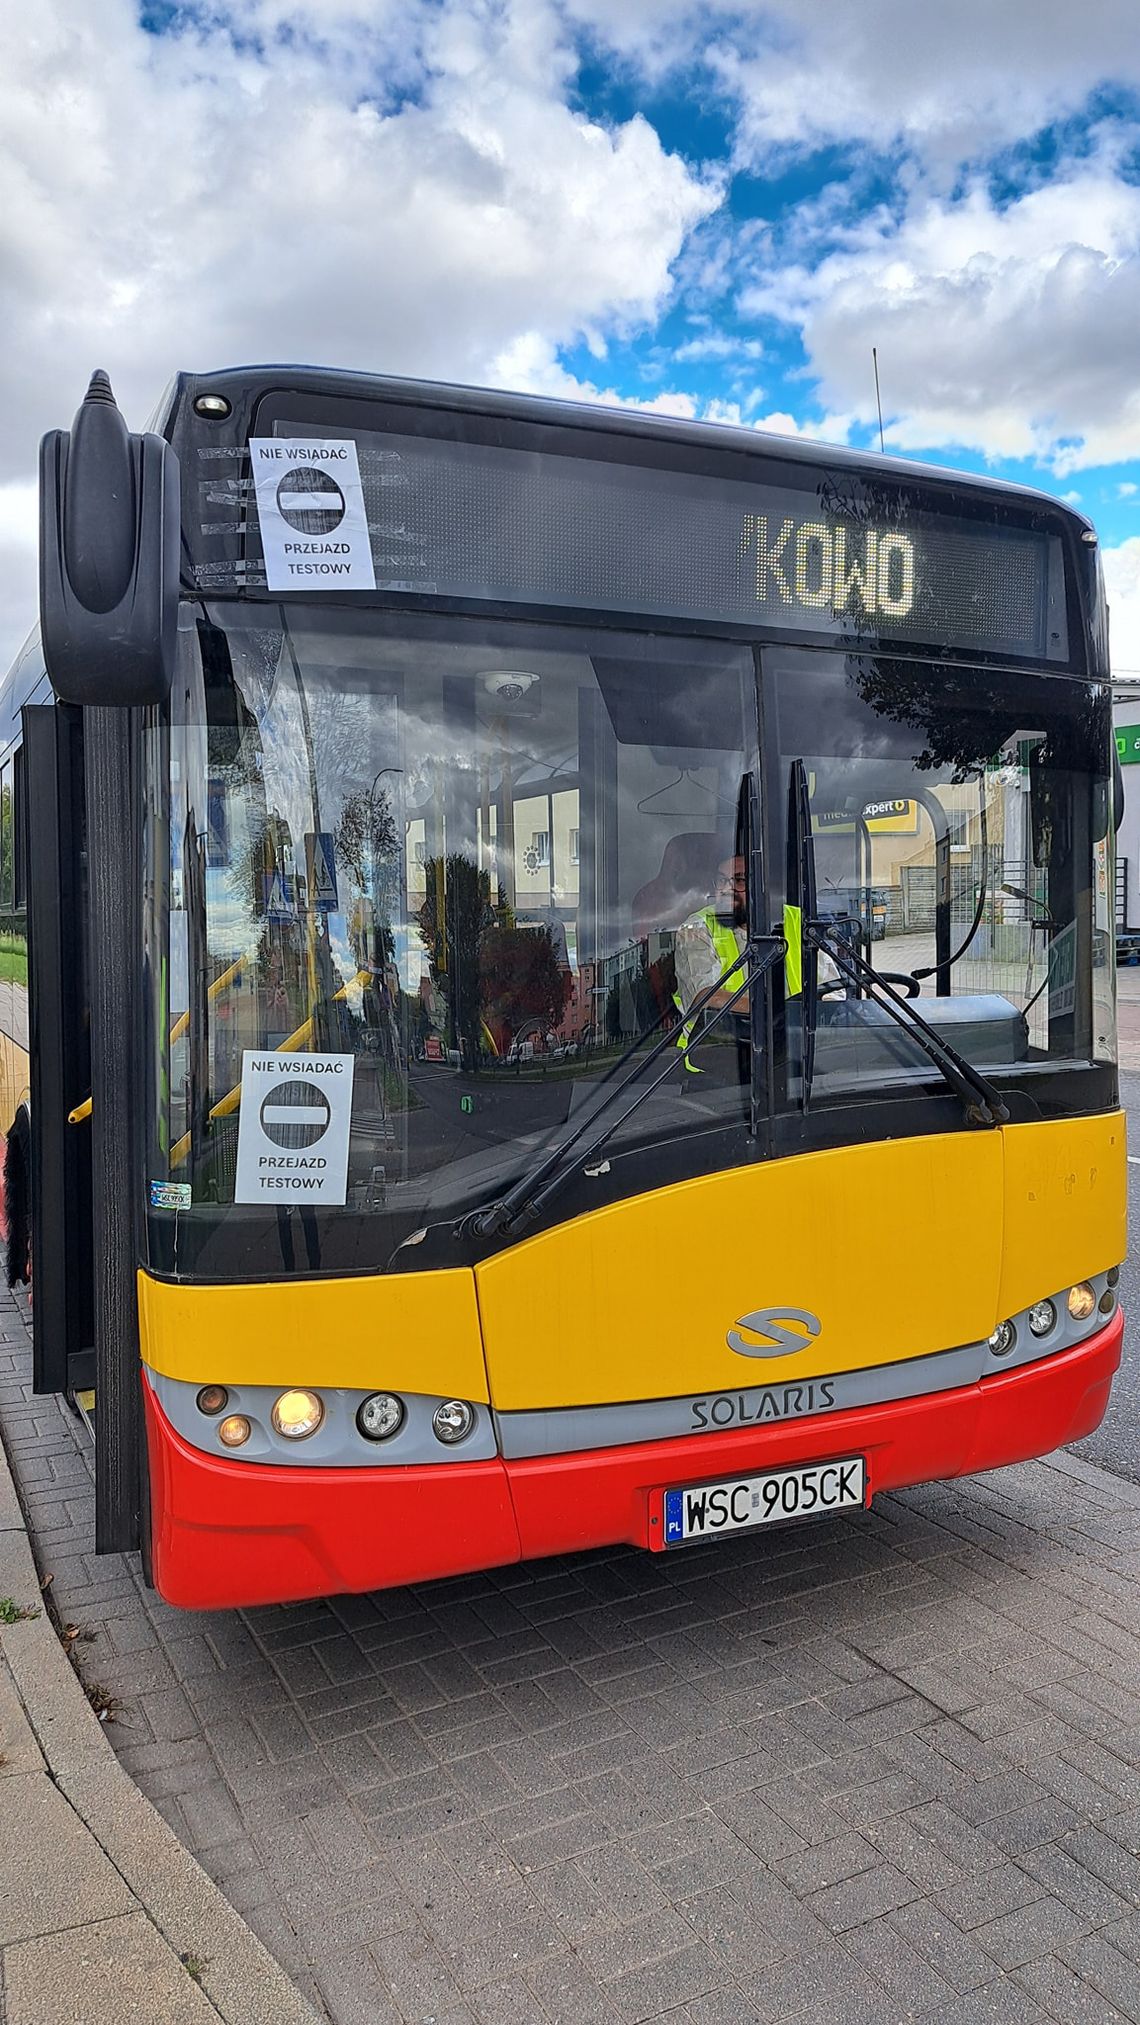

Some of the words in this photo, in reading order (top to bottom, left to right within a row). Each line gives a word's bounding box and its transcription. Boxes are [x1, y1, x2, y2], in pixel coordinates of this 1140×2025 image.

[259, 448, 283, 460] NIE
[287, 446, 348, 460] WSIADAĆ
[284, 543, 351, 554] PRZEJAZD
[288, 563, 352, 575] TESTOWY
[862, 800, 895, 816] xpert
[251, 1061, 275, 1072] NIE
[278, 1060, 344, 1074] WSIADAĆ
[258, 1156, 327, 1169] PRZEJAZD
[258, 1177, 325, 1189] TESTOWY
[690, 1381, 835, 1430] SOLARIS
[686, 1485, 750, 1533] WSC
[762, 1463, 858, 1518] 905CK
[668, 1522, 681, 1533] PL
